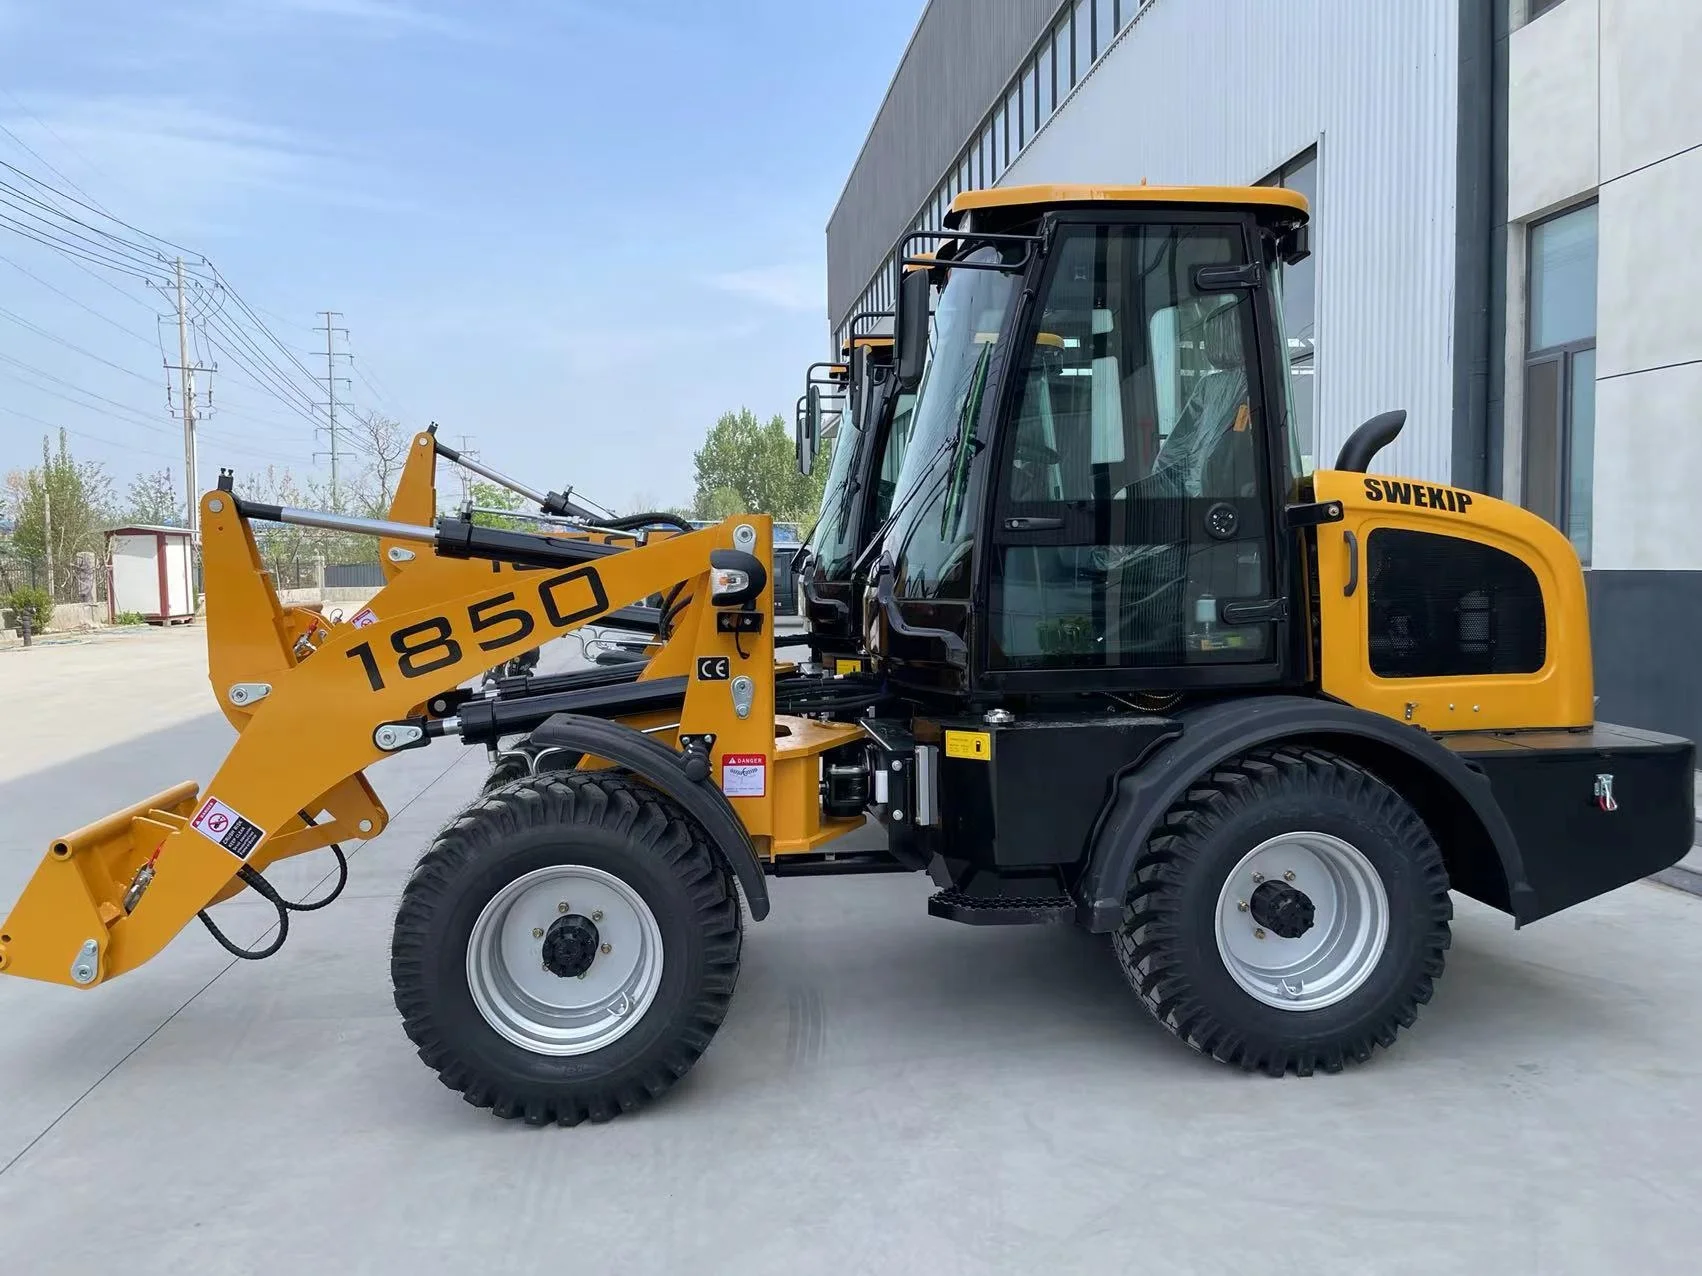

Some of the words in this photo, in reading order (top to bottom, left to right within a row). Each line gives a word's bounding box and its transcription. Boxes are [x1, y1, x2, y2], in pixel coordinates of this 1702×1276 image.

[1363, 478, 1473, 514] SWEKIP
[345, 565, 610, 692] 1850
[701, 660, 726, 678] CE
